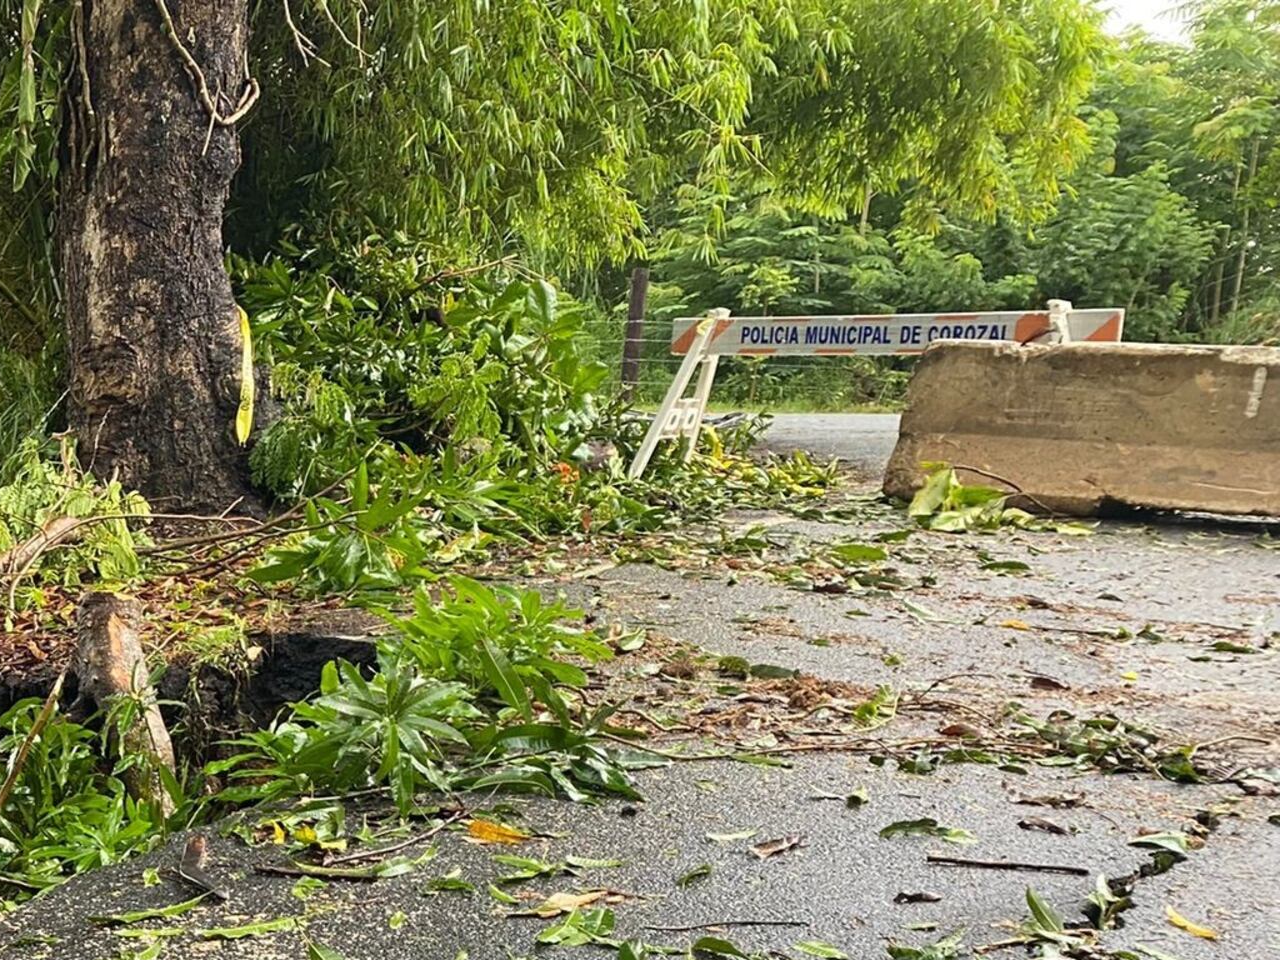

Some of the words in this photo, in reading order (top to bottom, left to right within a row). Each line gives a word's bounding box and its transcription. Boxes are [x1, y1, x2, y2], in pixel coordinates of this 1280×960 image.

[741, 326, 799, 344] POLICIA
[805, 326, 891, 344] MUNICIPAL
[900, 326, 922, 344] DE
